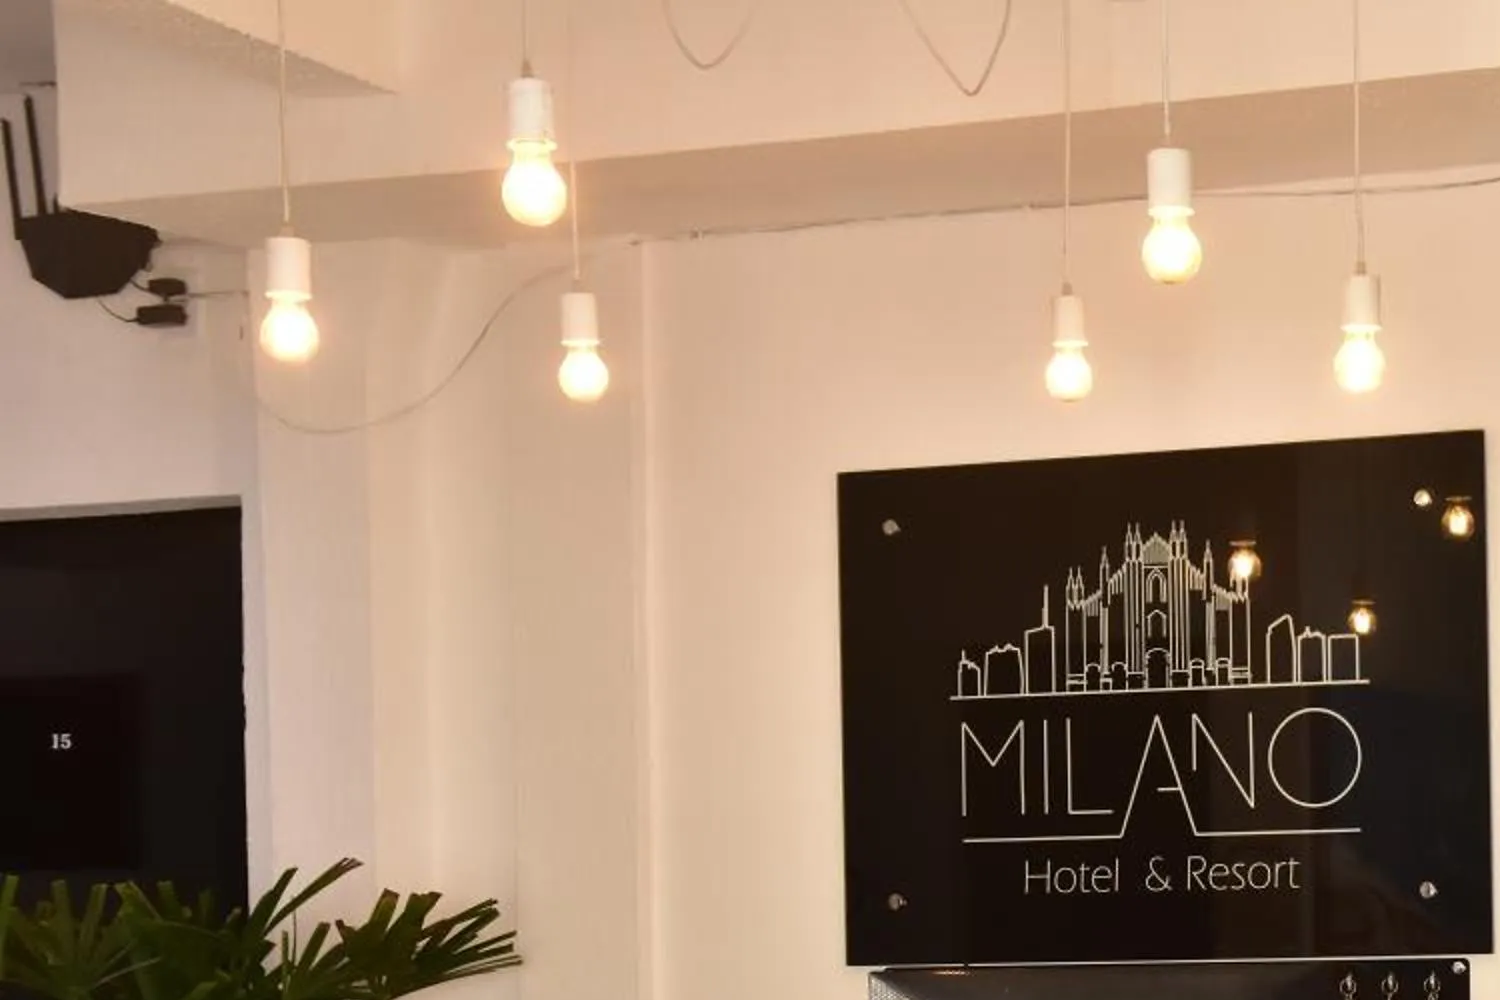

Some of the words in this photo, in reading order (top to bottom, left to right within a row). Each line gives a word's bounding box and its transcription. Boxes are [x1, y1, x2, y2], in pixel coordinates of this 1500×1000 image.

[52, 732, 72, 750] 15
[961, 706, 1363, 838] MILANO
[1023, 859, 1121, 895] Hotel
[1144, 855, 1173, 892] &
[1184, 853, 1301, 892] Resort
